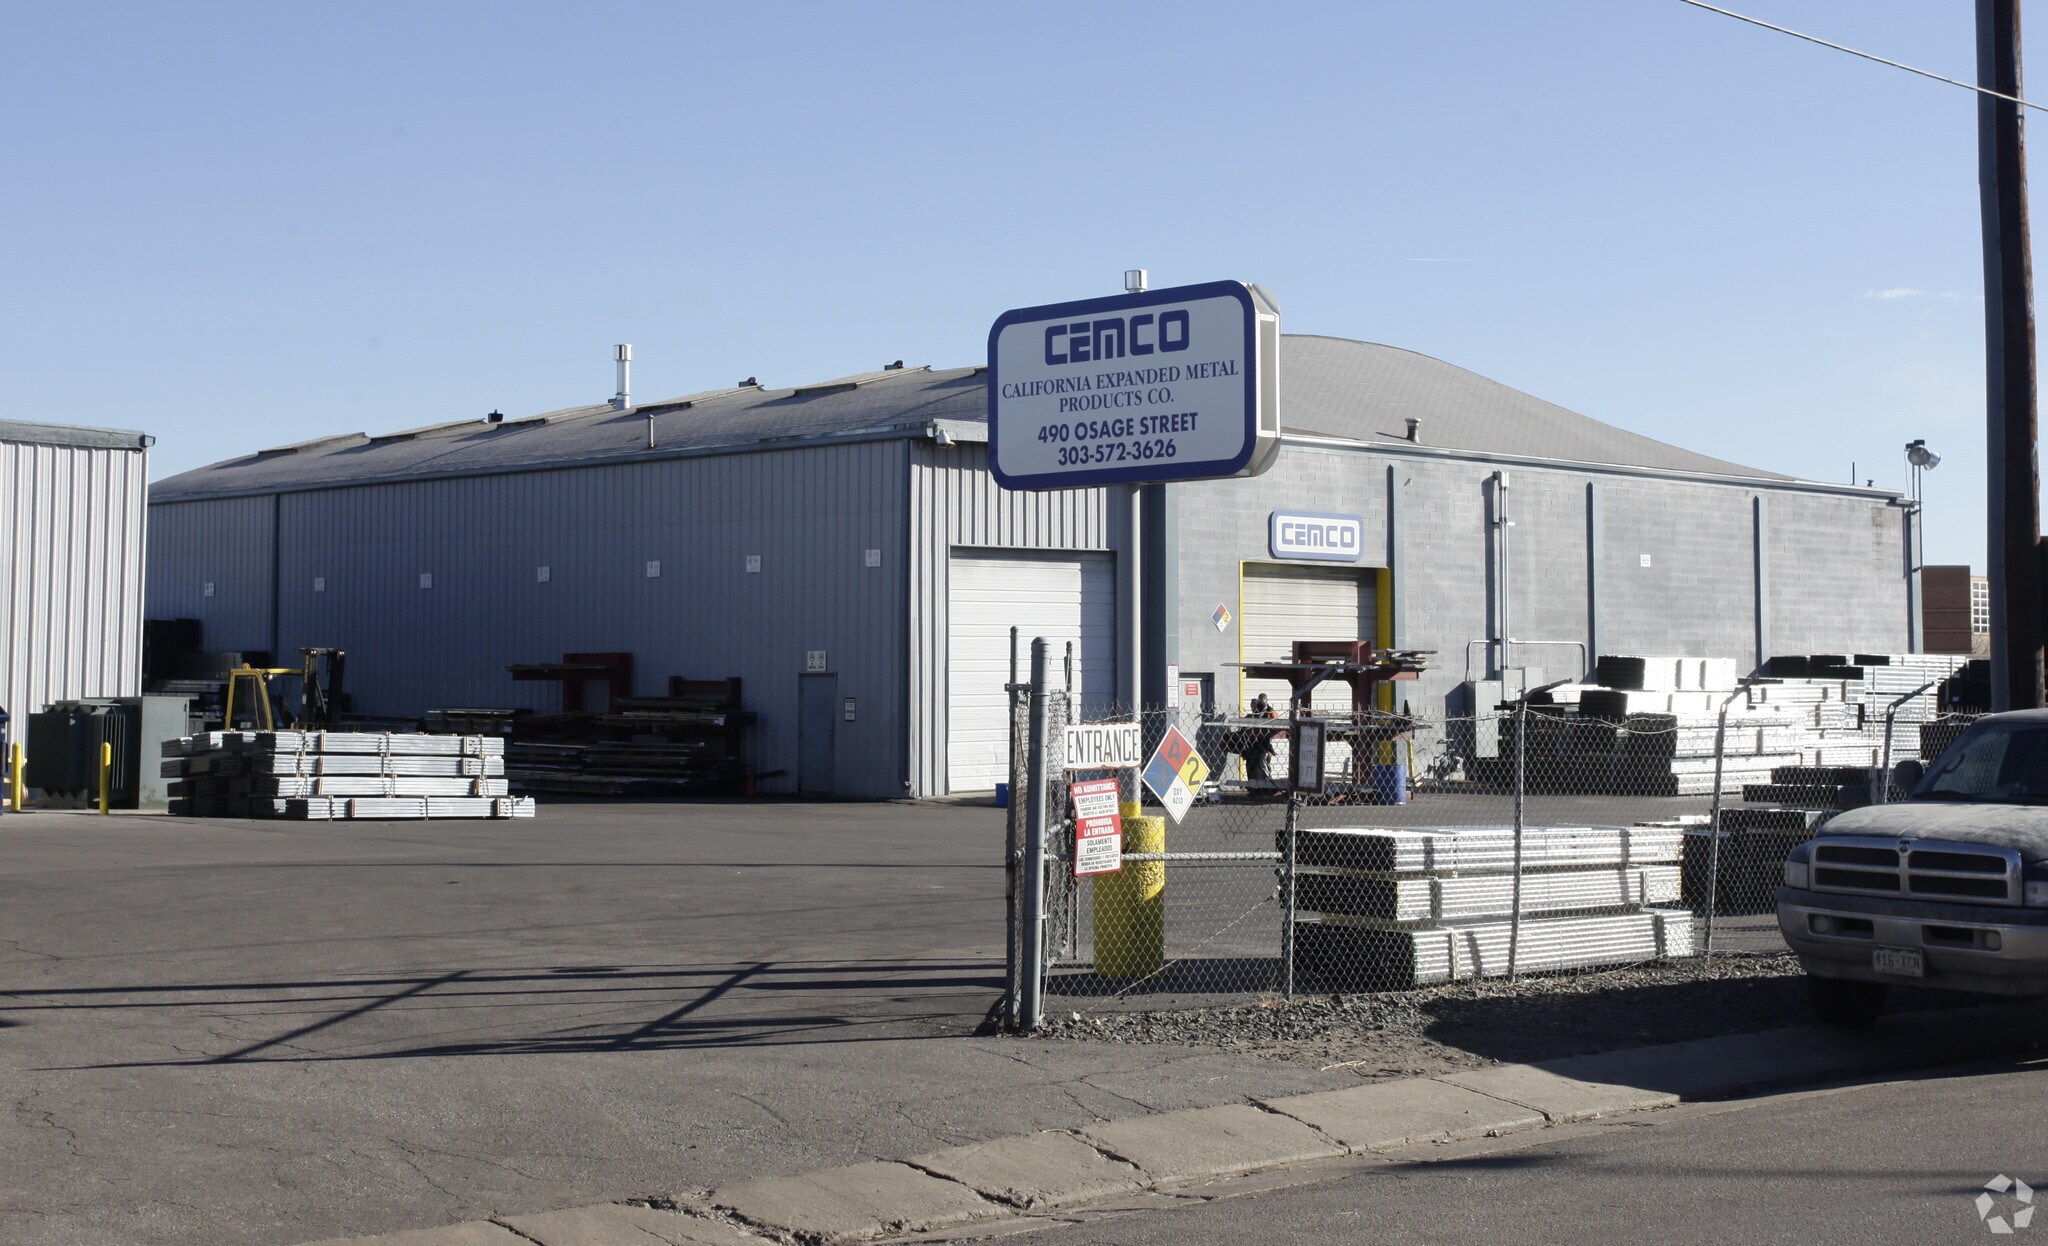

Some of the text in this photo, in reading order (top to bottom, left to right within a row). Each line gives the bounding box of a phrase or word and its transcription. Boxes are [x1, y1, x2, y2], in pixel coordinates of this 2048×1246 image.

[1045, 309, 1190, 366] CEMCO
[1002, 360, 1239, 399] CALIFORNIA EXPANDED METAL
[1059, 387, 1174, 413] PRODUCTS CO.
[1037, 412, 1198, 443] 490 OSAGE STREET
[1058, 439, 1177, 466] 303-572-3626
[1281, 522, 1355, 548] CEMCO
[1067, 729, 1139, 764] ENTRANCE
[1187, 756, 1200, 786] 2
[1074, 782, 1116, 794] NO ADMITTANCE
[1078, 796, 1104, 804] EMPLOYEES
[1172, 788, 1182, 796] OXY
[1084, 826, 1114, 836] LA ENTRADA
[1086, 817, 1112, 828] PROHIBIDA
[1086, 837, 1112, 846] SOLAMENTE
[1086, 845, 1112, 854] EMPLEADOS
